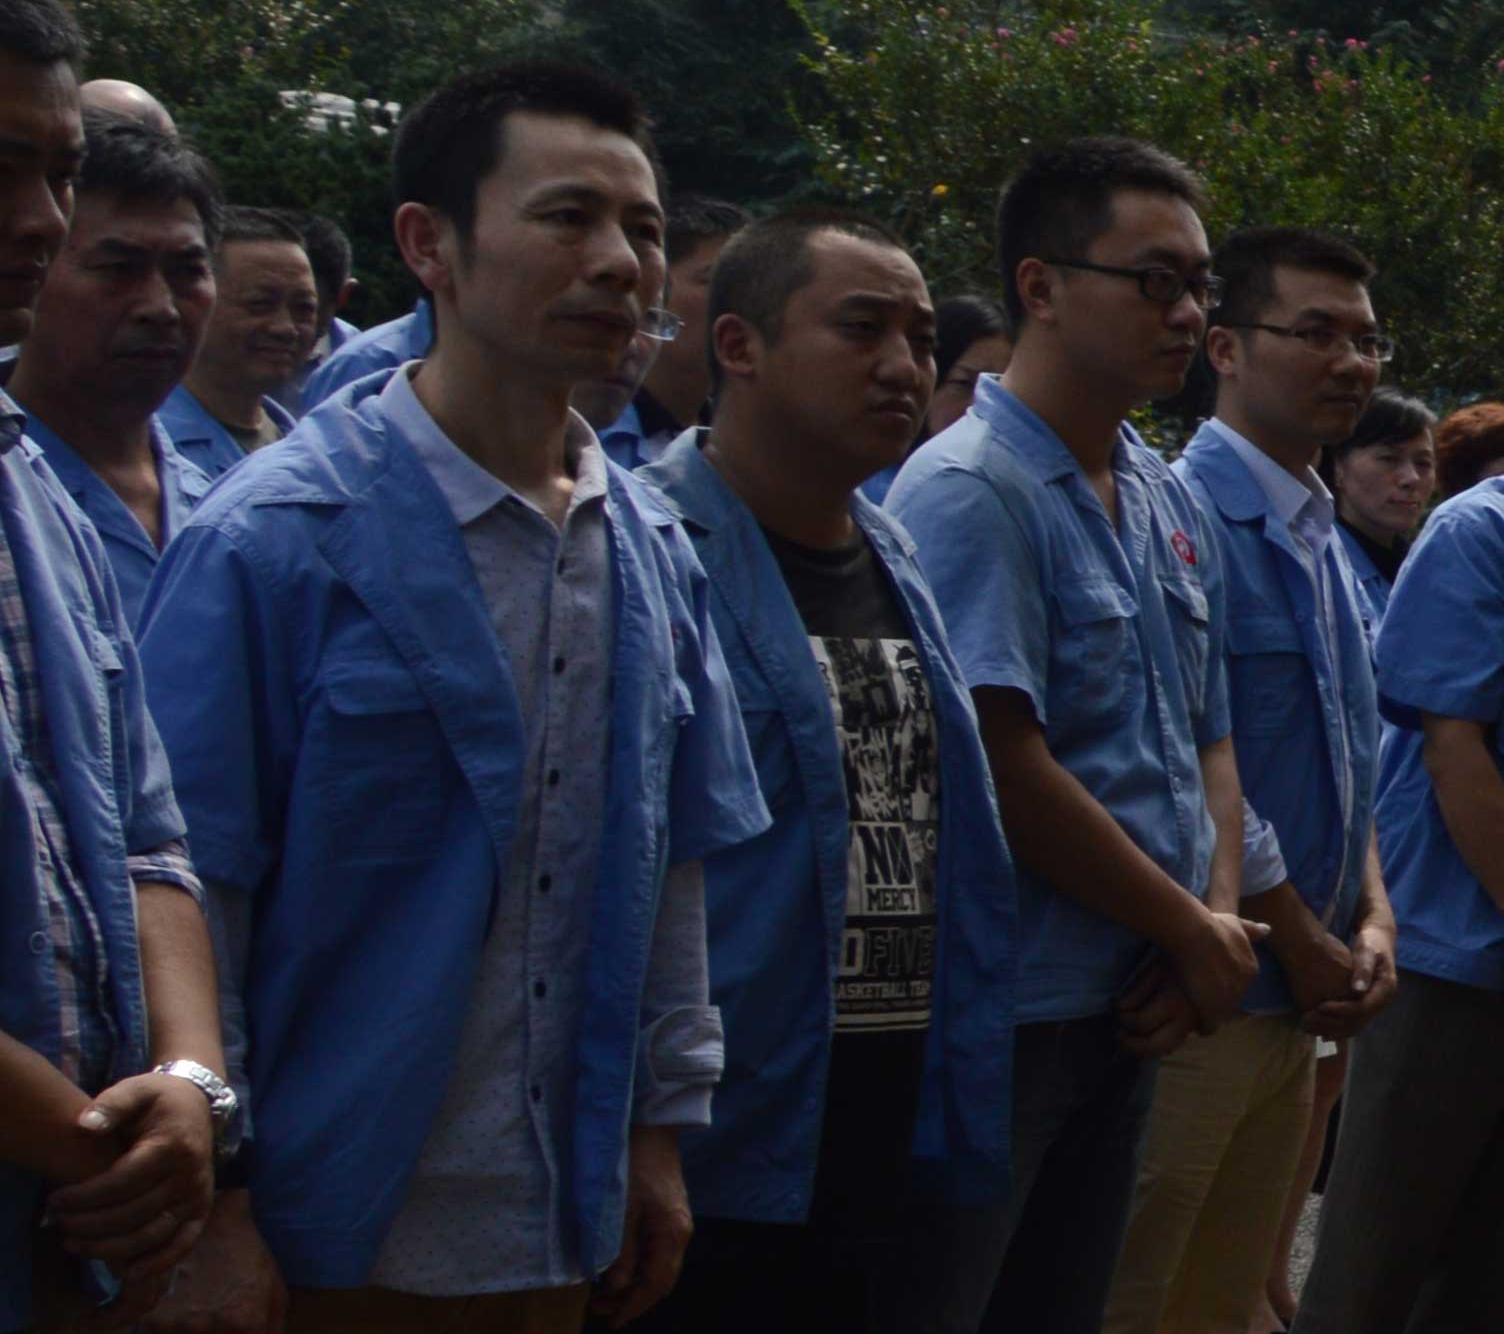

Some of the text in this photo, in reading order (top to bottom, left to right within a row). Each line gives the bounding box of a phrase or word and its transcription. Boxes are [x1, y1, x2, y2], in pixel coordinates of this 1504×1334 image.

[857, 825, 913, 885] NO
[867, 887, 917, 912] MERCY
[836, 981, 908, 999] ASKETBALL
